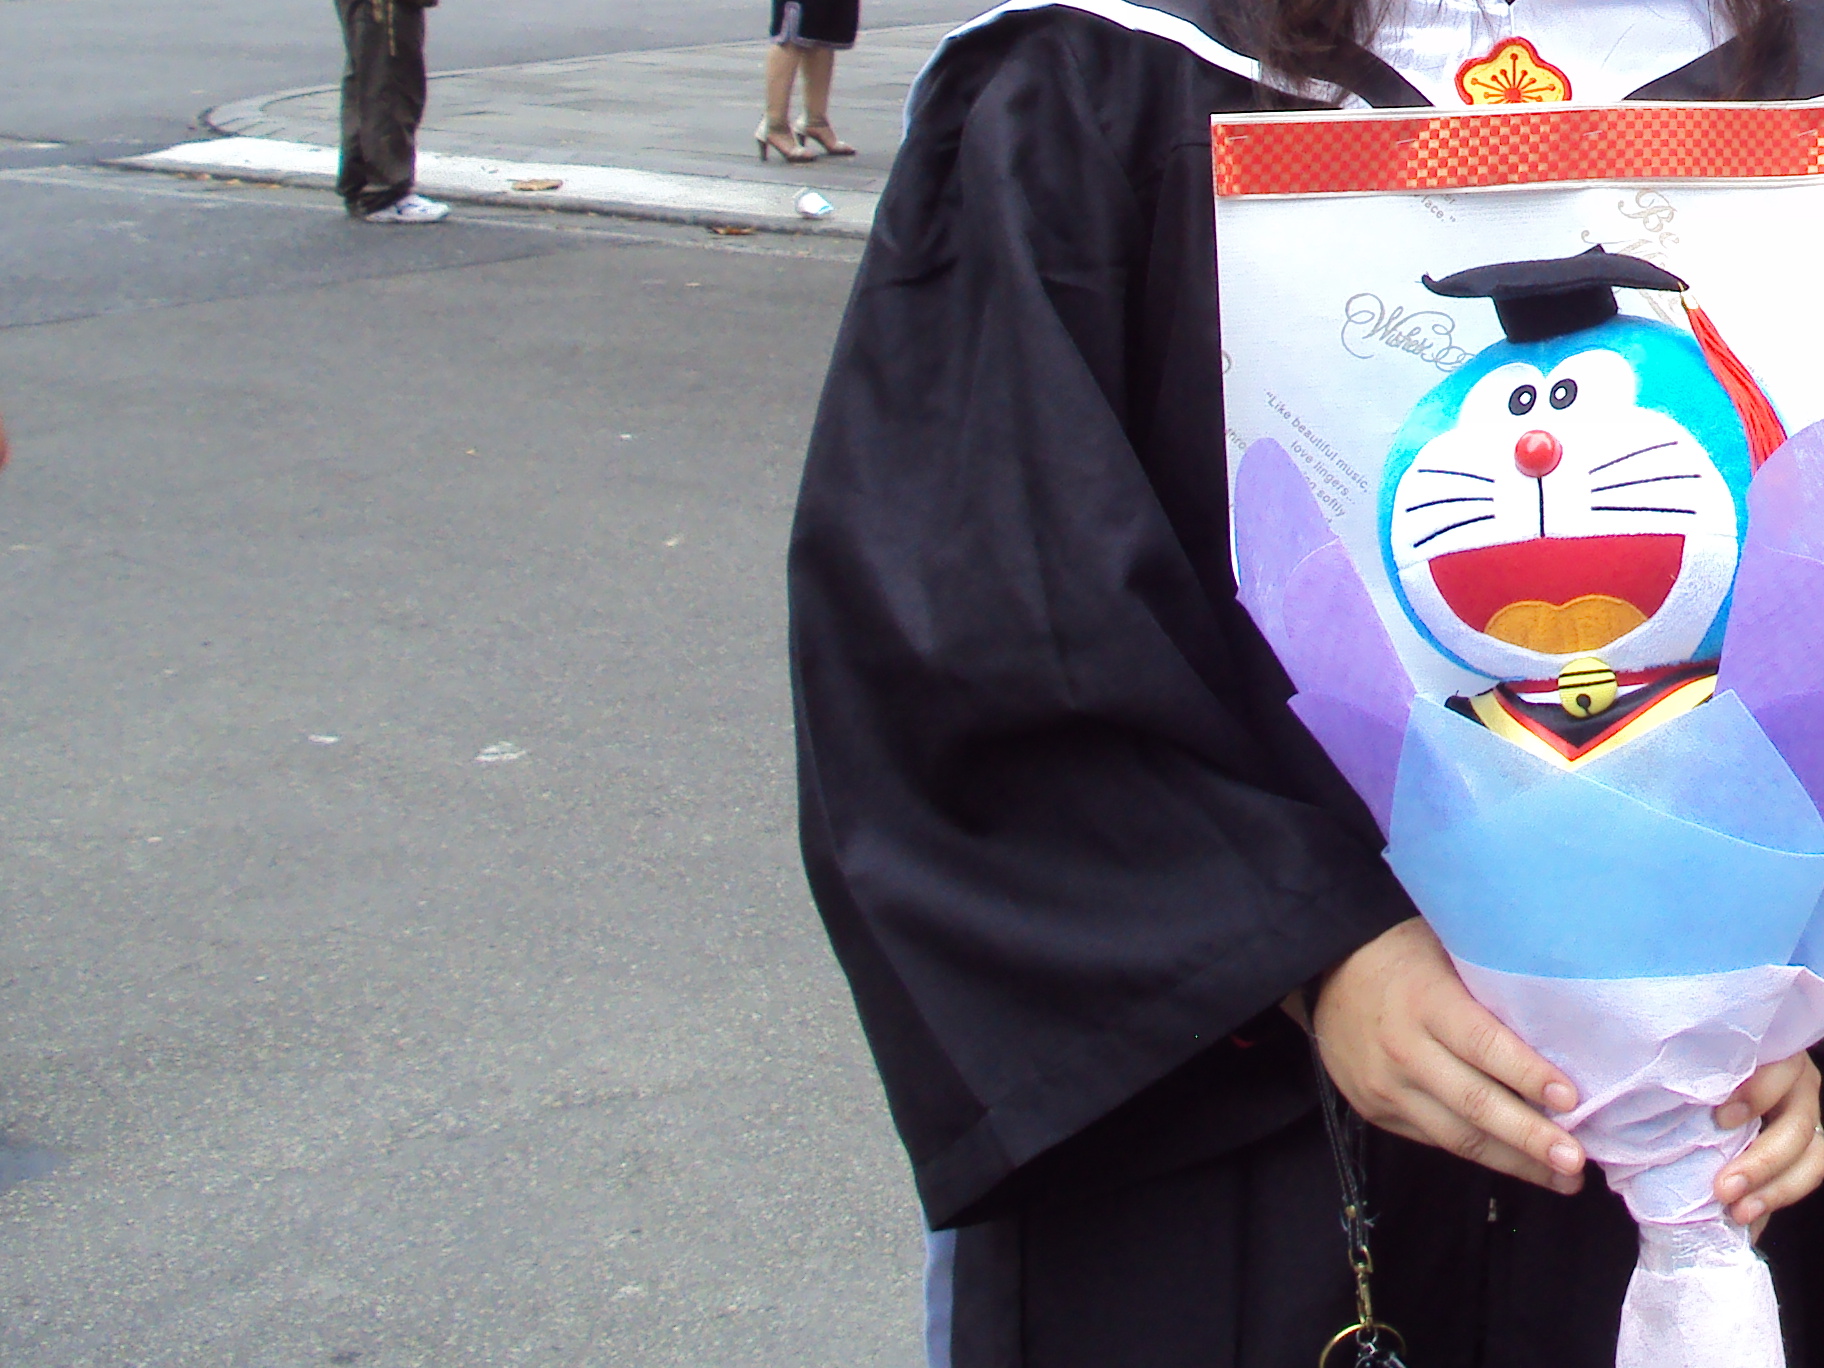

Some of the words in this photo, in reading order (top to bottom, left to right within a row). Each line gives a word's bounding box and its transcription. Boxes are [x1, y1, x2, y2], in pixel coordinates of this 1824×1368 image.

[1290, 440, 1314, 464] love
[1291, 416, 1339, 462] beautiful
[1335, 459, 1369, 493] music,
[1316, 489, 1346, 518] softly
